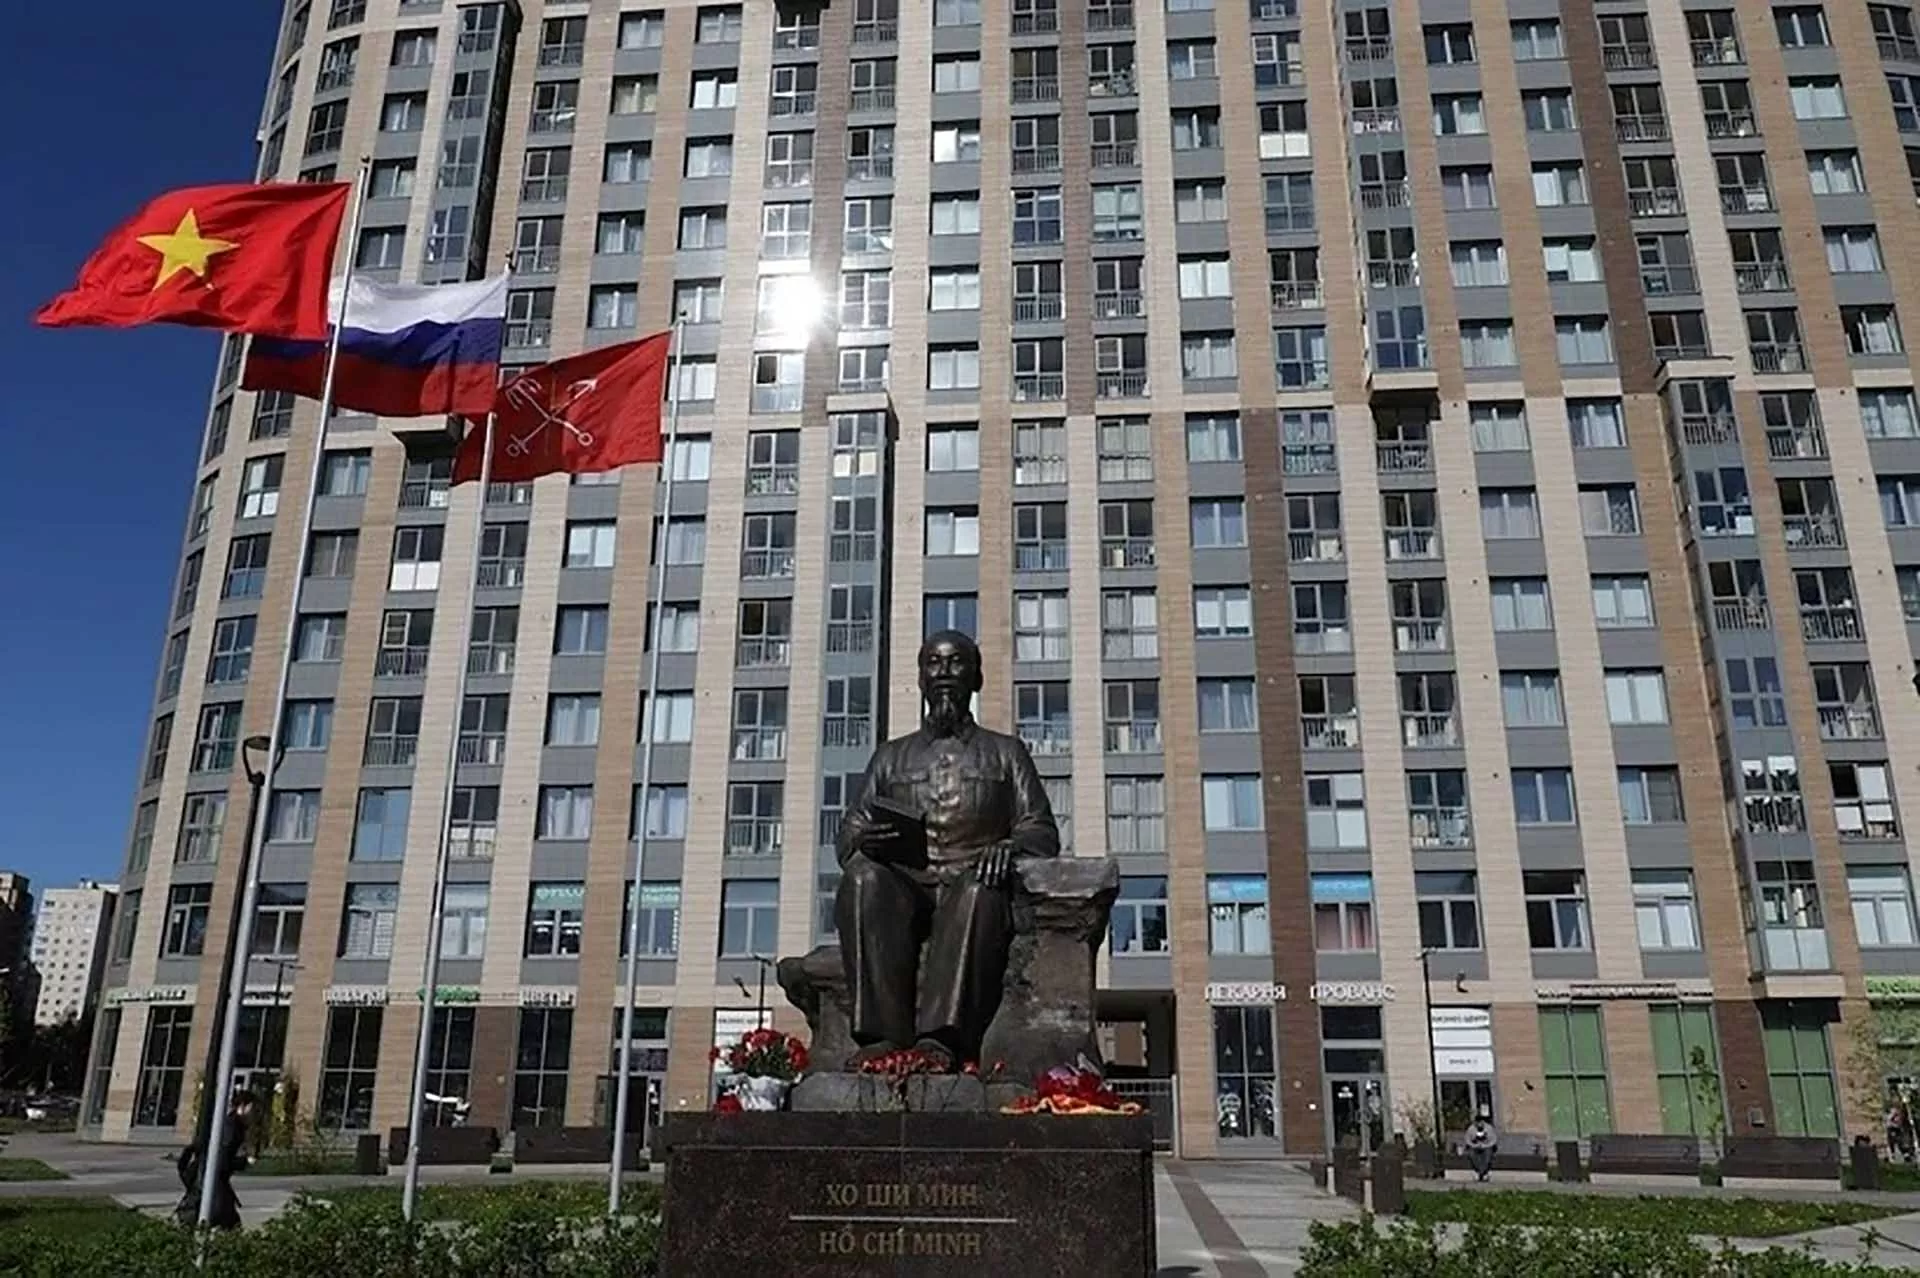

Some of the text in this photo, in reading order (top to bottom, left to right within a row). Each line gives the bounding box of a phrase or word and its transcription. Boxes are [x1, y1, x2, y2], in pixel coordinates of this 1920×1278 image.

[1204, 983, 1396, 1002] ПЕКАРНЯ ПРОВАНС
[826, 1183, 978, 1206] ХО ШИ МИН
[863, 1225, 905, 1256] CHÍ
[913, 1231, 981, 1256] MINH
